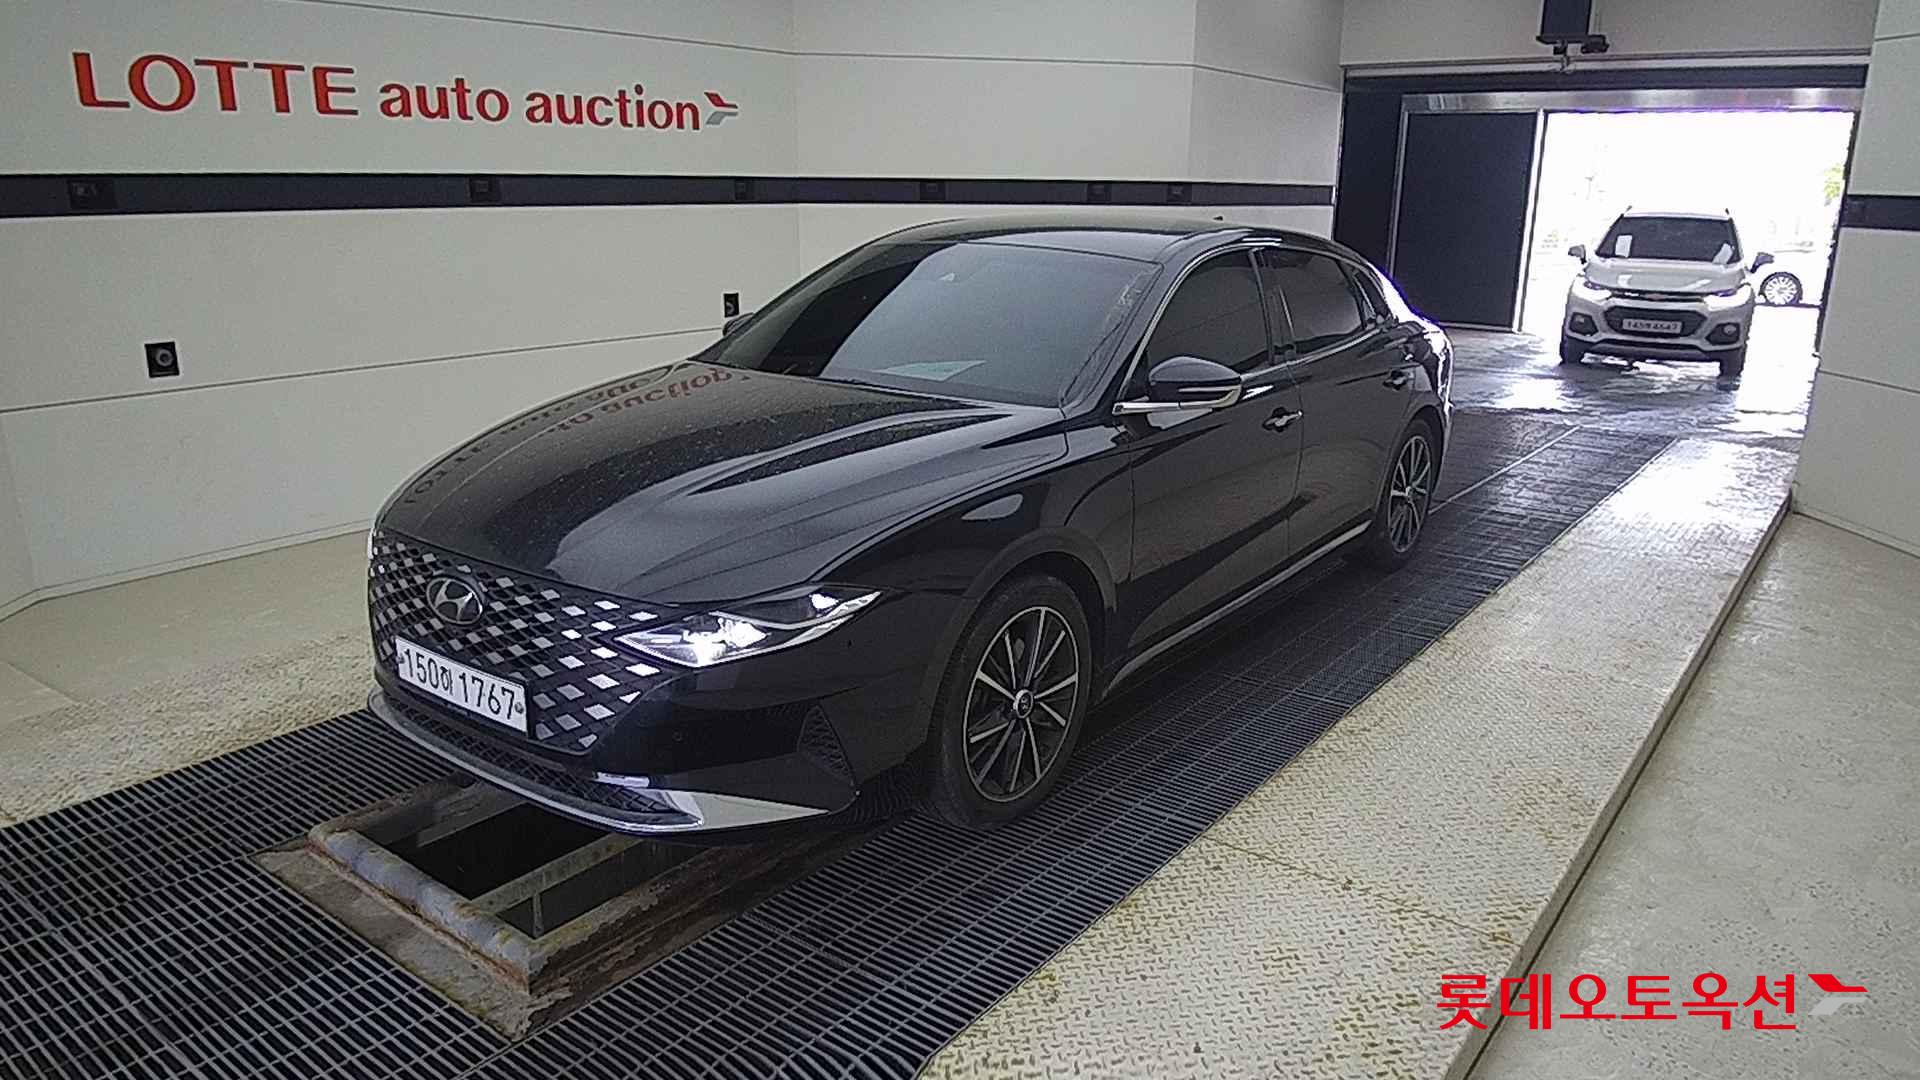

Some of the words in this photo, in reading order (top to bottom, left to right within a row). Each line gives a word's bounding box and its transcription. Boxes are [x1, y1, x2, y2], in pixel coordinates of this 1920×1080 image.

[73, 52, 359, 116] LOTTE
[379, 78, 510, 122] auto
[525, 85, 700, 131] auction
[459, 672, 515, 720] 1767
